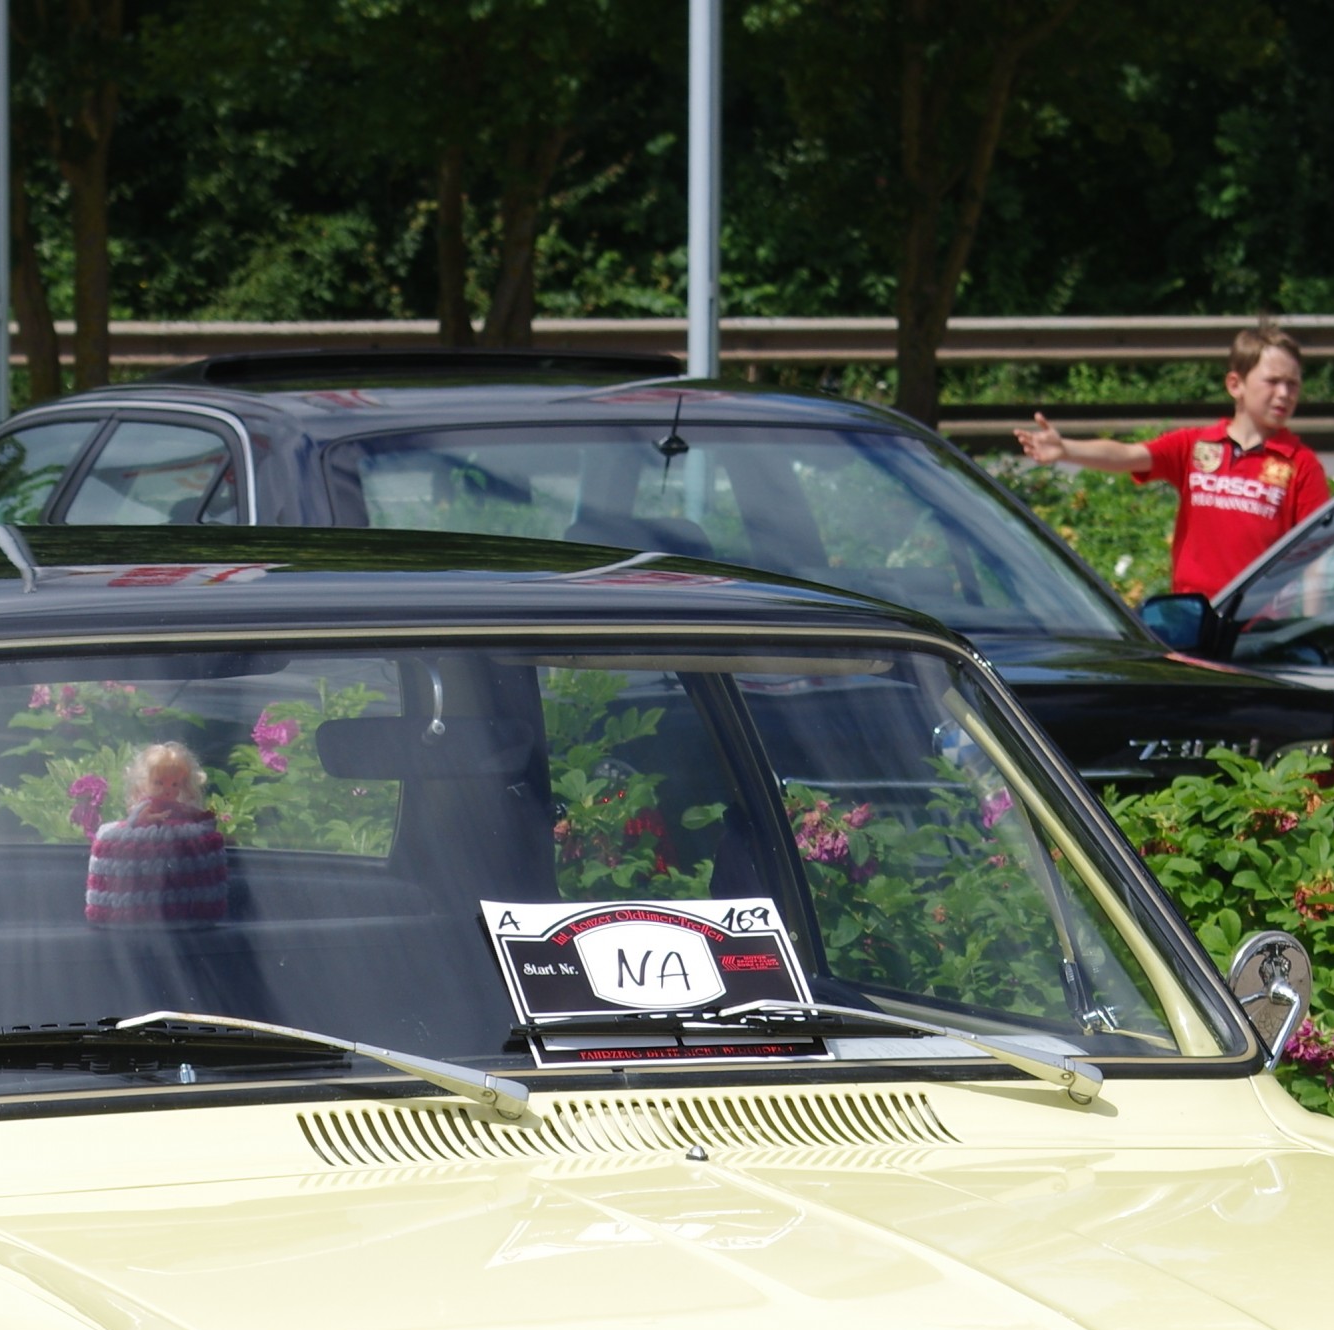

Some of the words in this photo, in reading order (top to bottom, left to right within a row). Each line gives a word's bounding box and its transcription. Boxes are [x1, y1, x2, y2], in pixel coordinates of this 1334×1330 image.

[1189, 472, 1286, 505] PORSCHE
[498, 911, 521, 931] A
[551, 931, 573, 946] Int.
[569, 914, 612, 935] Konzer
[615, 911, 725, 943] Oldtimer-Treffen
[721, 907, 770, 931] 169
[523, 962, 557, 976] Start
[559, 963, 579, 975] Nr.
[617, 948, 691, 991] NA
